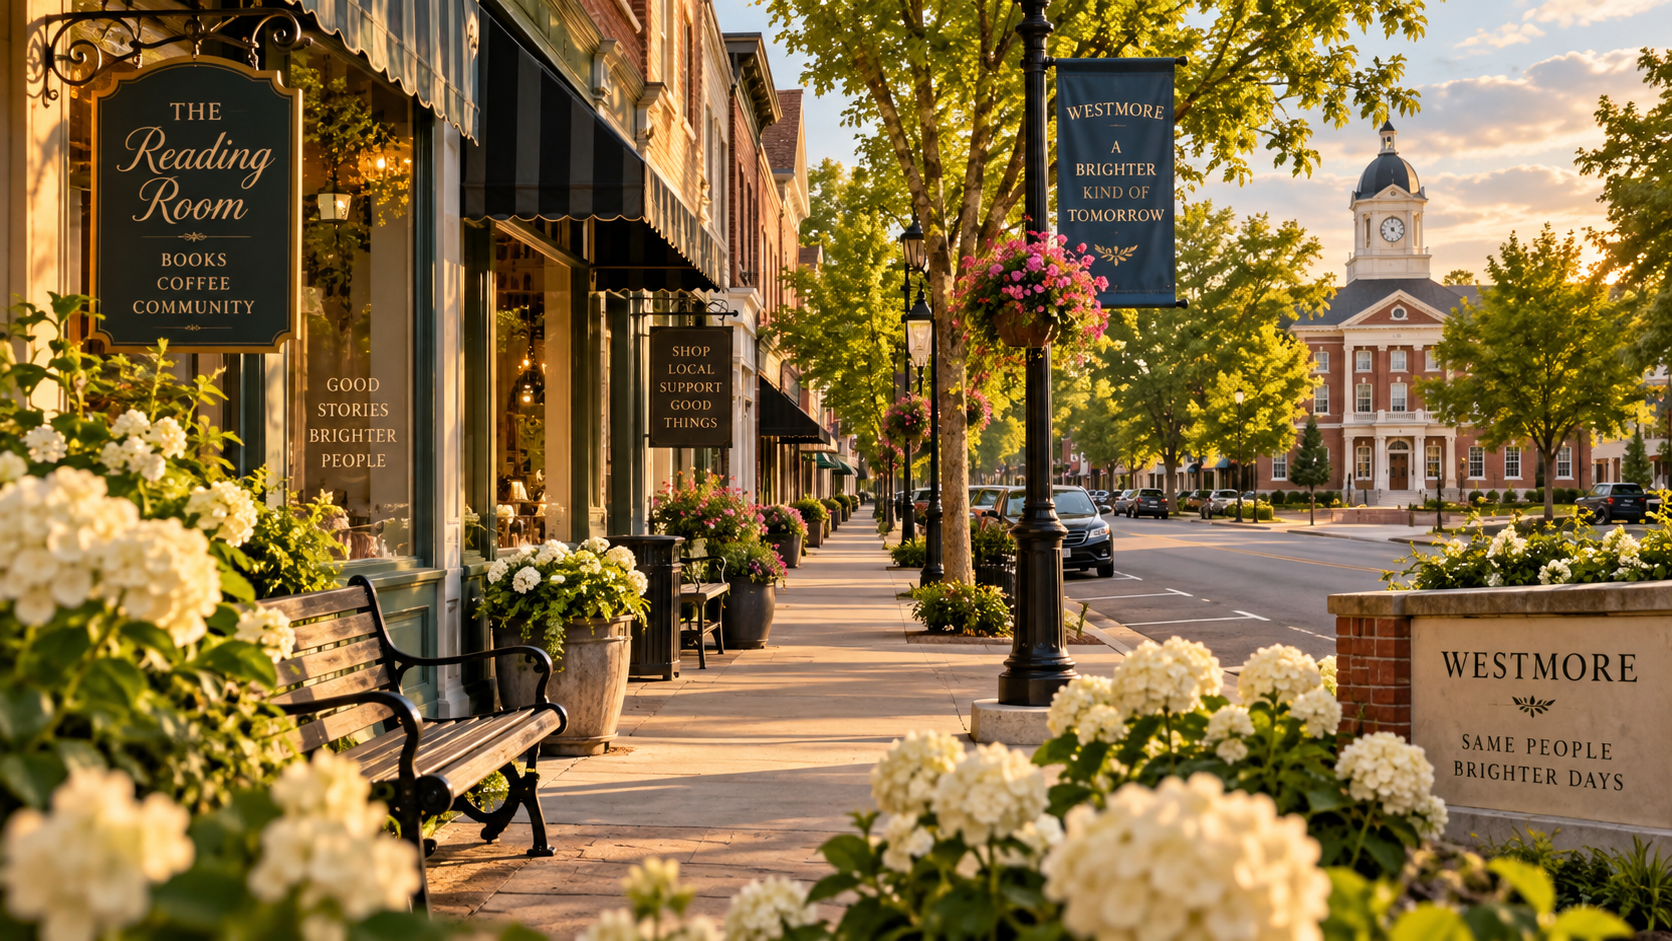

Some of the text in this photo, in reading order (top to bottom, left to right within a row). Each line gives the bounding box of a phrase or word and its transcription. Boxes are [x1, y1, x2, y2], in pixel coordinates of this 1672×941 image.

[169, 102, 222, 121] THE
[1066, 101, 1165, 121] WESTMORE
[1110, 140, 1122, 154] A
[116, 126, 275, 190] Reading
[1076, 162, 1157, 176] BRIGHTER
[1083, 185, 1150, 200] KIND OF
[132, 176, 249, 225] Room
[1067, 208, 1165, 222] TOMORROW
[161, 252, 227, 268] BOOKS
[156, 276, 230, 291] COFFEE
[132, 299, 255, 315] COMMUNITY
[672, 345, 711, 357] SHOP
[668, 363, 715, 375] LOCAL
[326, 377, 380, 393] GOOD
[659, 381, 722, 393] SUPPORT
[318, 402, 389, 418] STORIES
[670, 399, 712, 411] GOOD
[663, 417, 718, 429] THINGS
[309, 428, 397, 443] BRIGHTER
[321, 453, 386, 468] PEOPLE
[1441, 650, 1639, 683] WESTMORE
[1461, 733, 1613, 761] SAME PEOPLE
[1453, 760, 1624, 792] BRIGHTER DAYS
